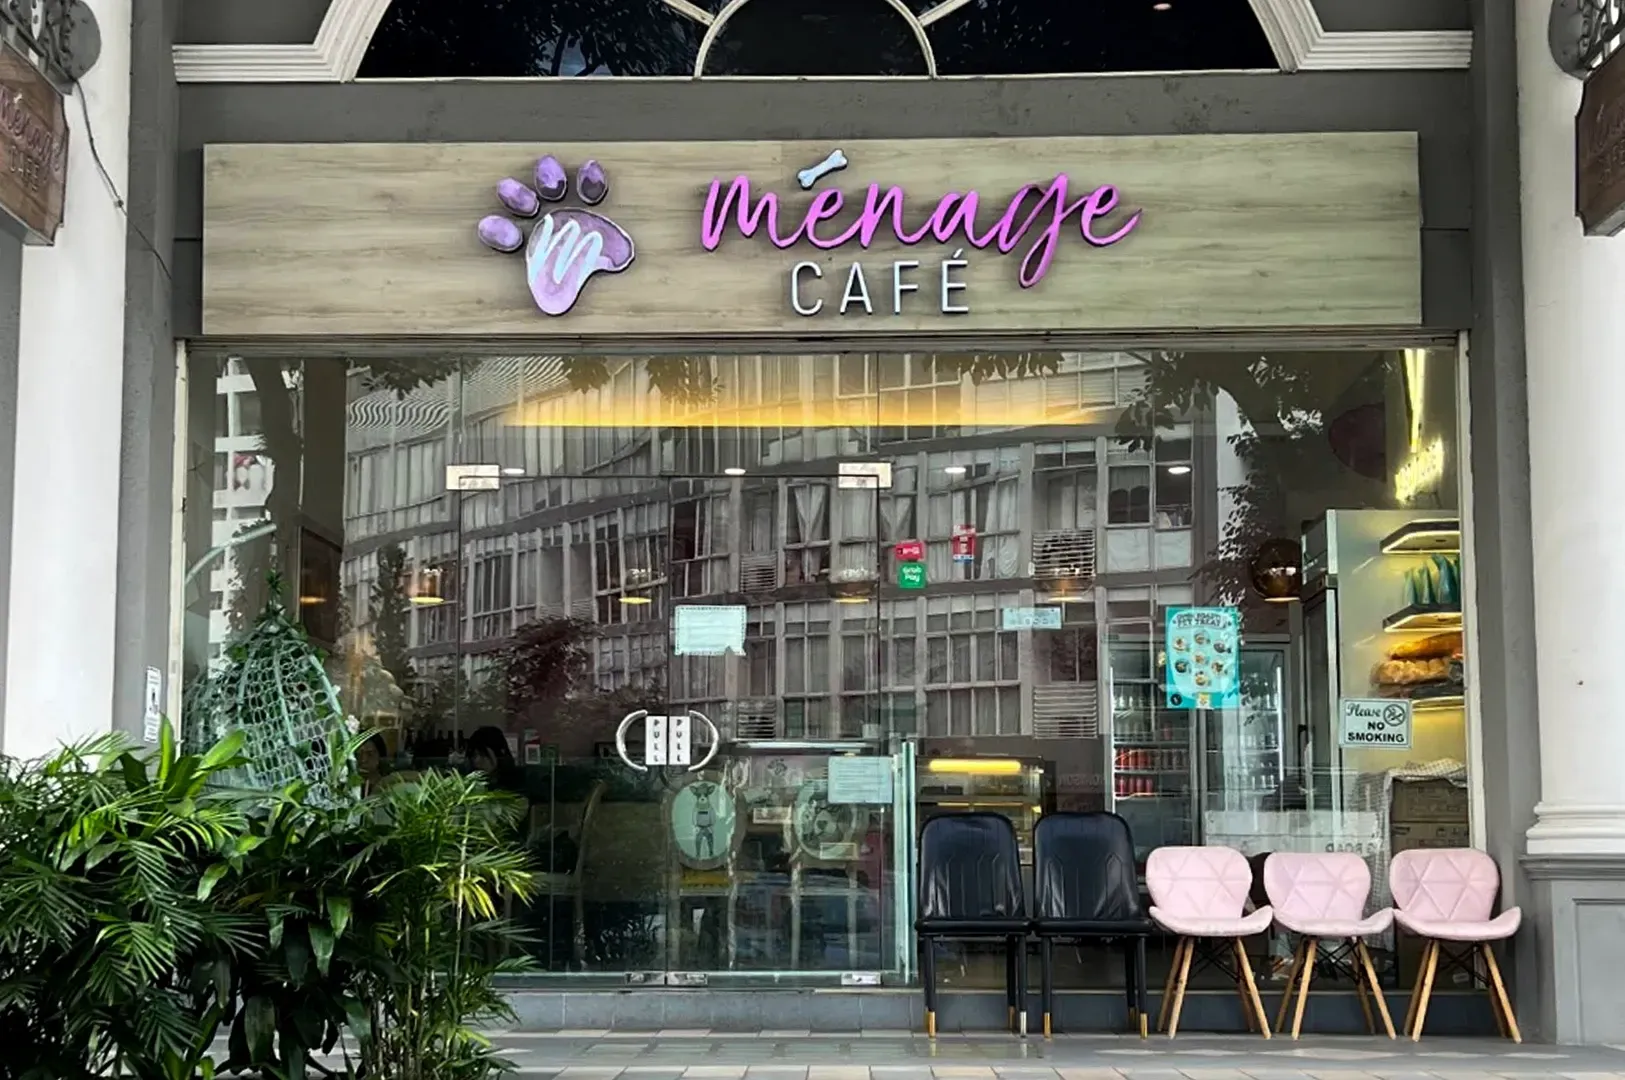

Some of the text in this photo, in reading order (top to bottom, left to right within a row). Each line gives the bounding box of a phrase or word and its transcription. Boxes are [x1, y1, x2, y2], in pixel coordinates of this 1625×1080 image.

[790, 248, 970, 316] CAFÉ
[1346, 703, 1381, 717] Please
[1367, 721, 1385, 730] NO
[1347, 731, 1405, 743] SMOKING
